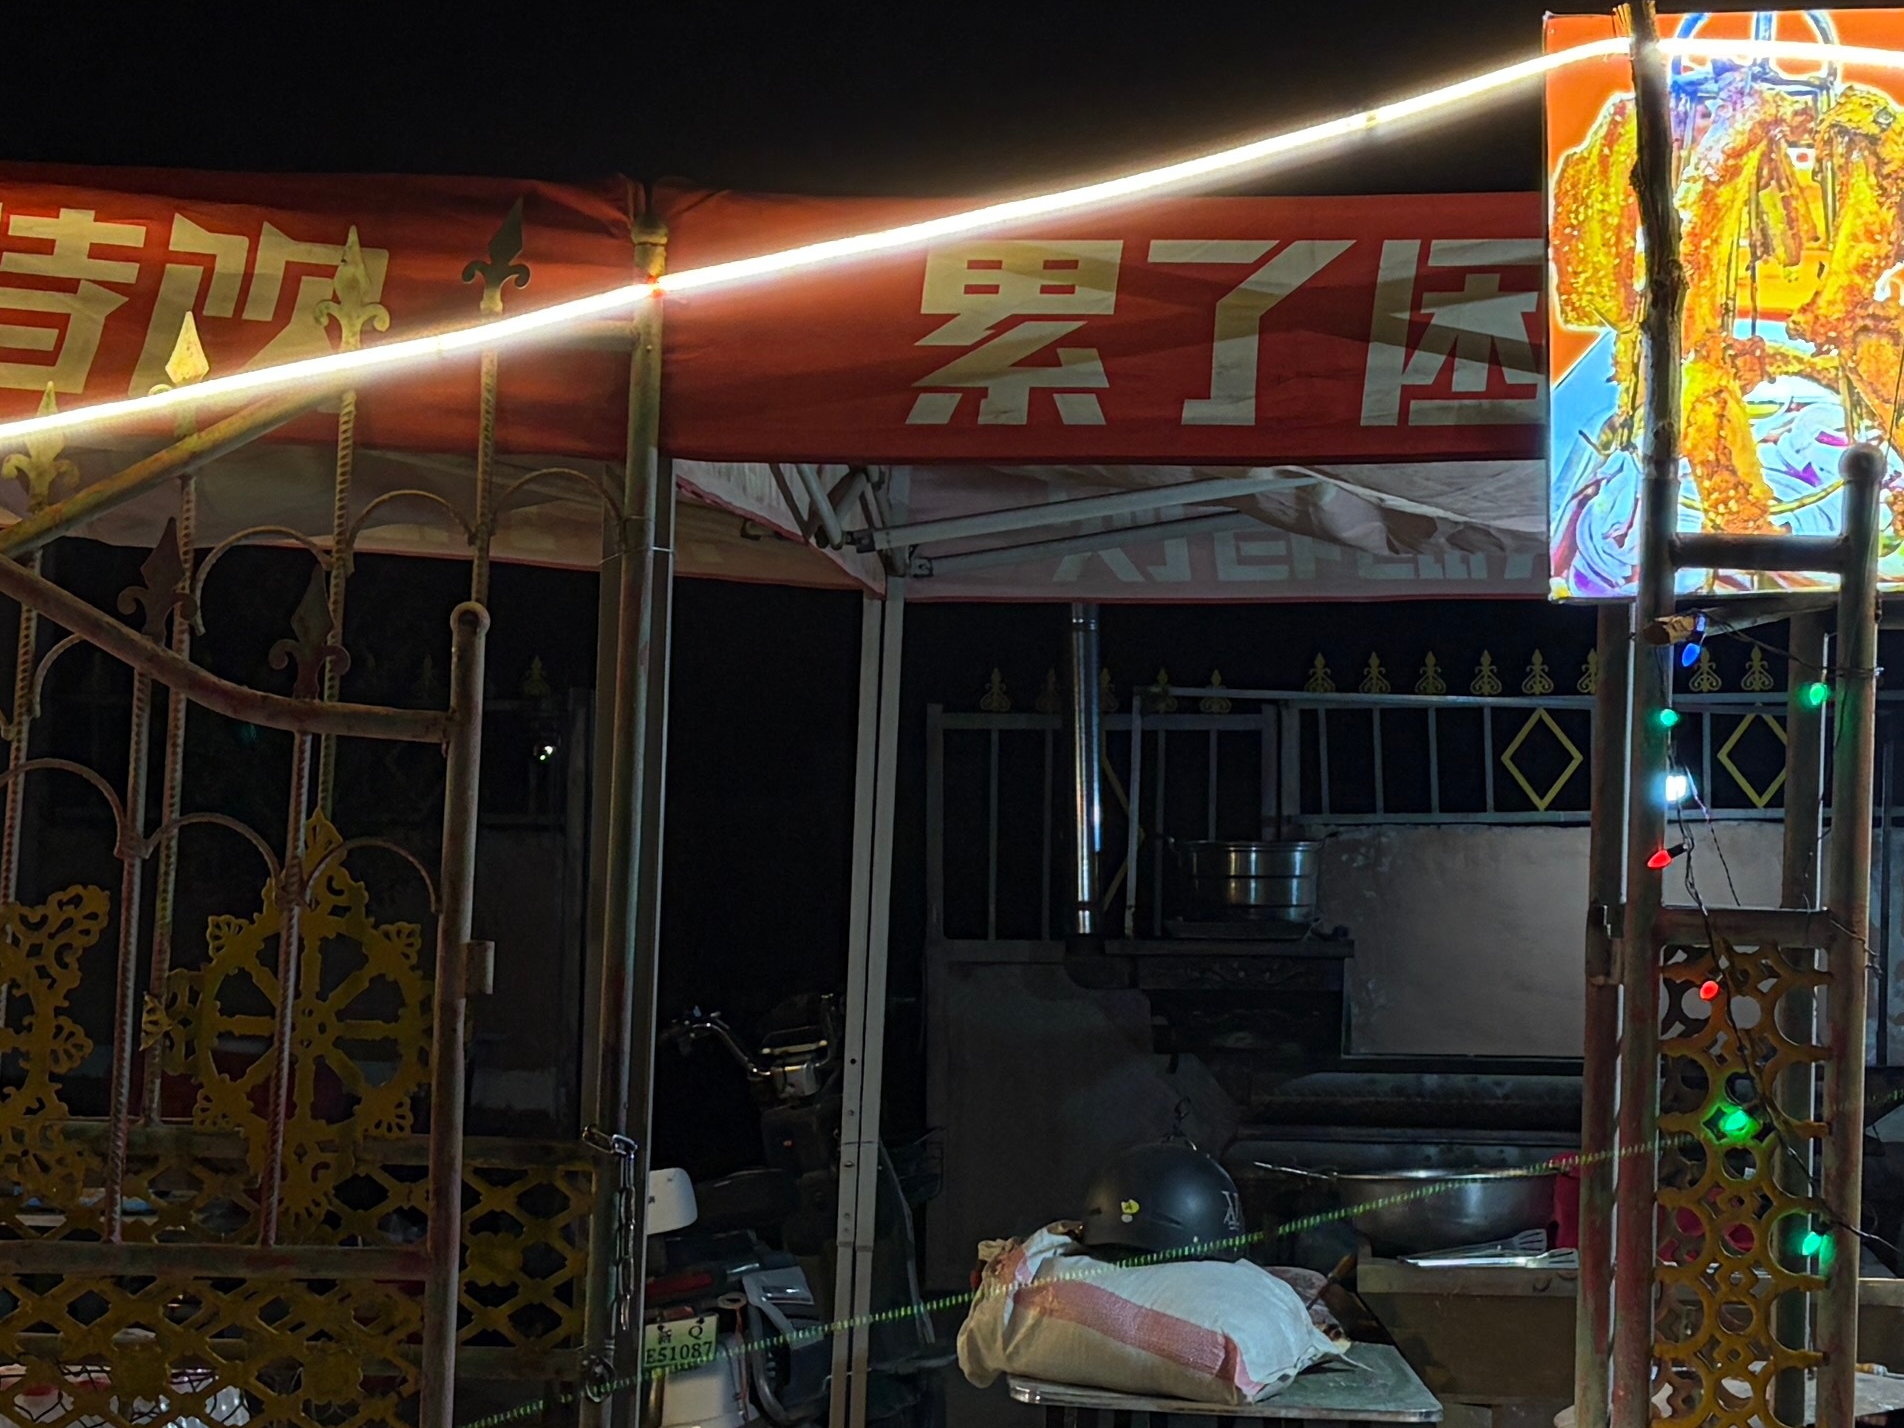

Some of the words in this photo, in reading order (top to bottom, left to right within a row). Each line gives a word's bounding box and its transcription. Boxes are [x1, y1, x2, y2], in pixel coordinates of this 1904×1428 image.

[905, 239, 1547, 428] 累了困
[646, 1341, 713, 1365] E51087
